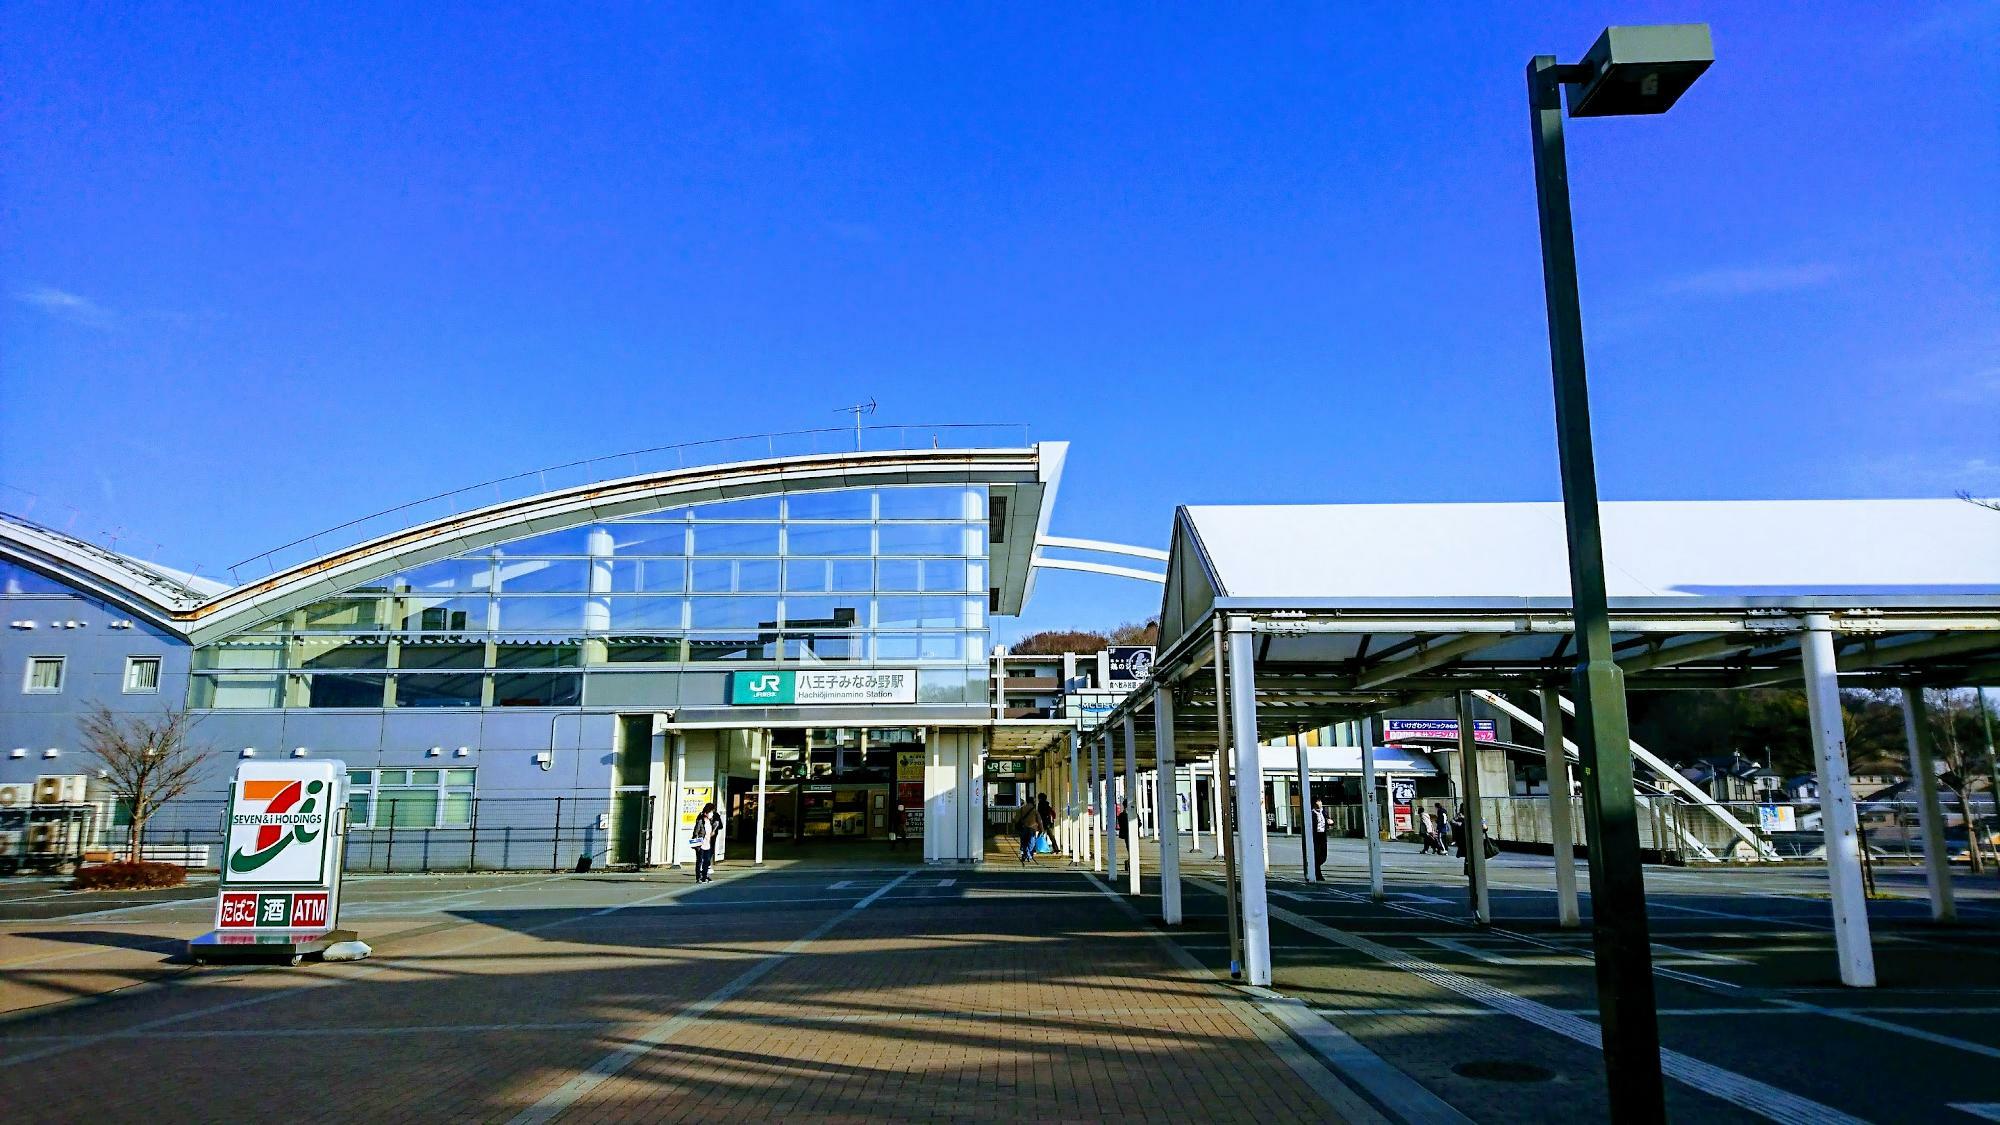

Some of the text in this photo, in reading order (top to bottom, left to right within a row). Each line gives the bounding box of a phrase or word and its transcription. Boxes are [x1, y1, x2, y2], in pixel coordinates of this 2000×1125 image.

[750, 675, 780, 691] JR
[799, 674, 905, 689] 八王子みなみ野駅
[987, 762, 999, 770] JR
[274, 814, 322, 824] HOLDINGS
[222, 899, 256, 922] たばこ
[262, 898, 286, 922] 酒
[293, 899, 326, 921] ATM
